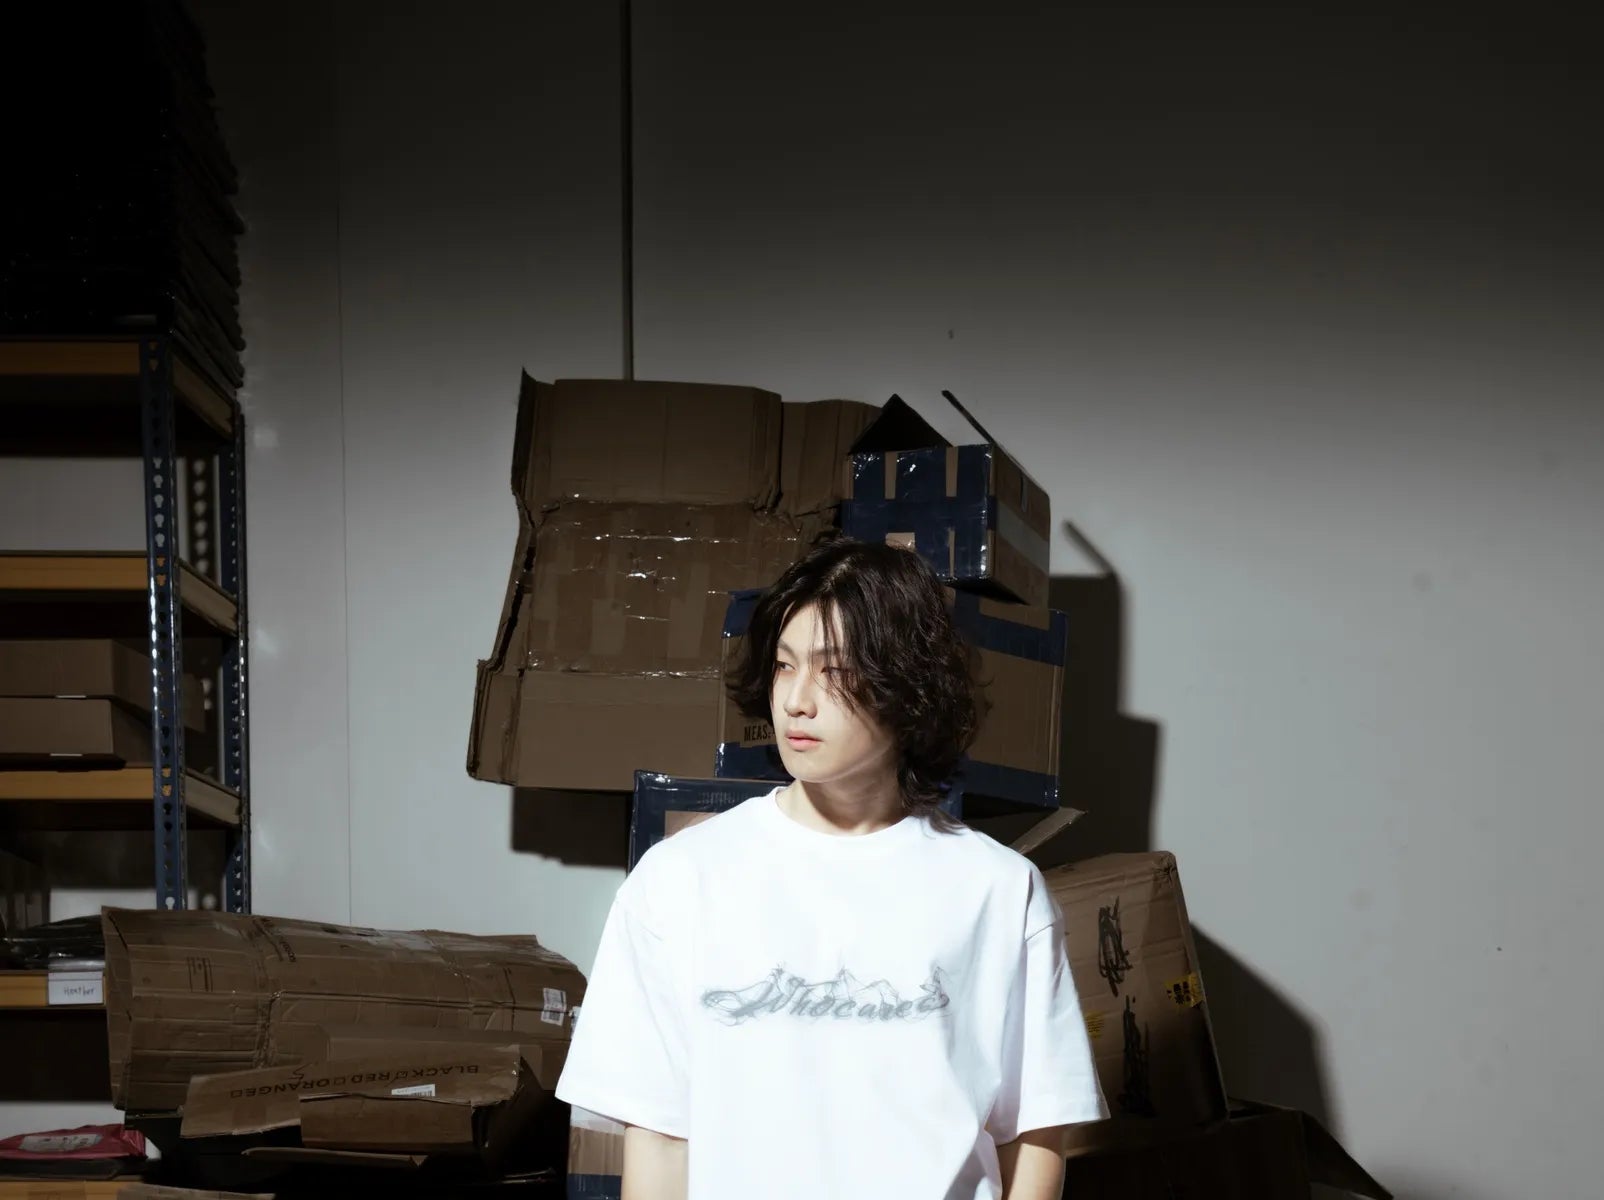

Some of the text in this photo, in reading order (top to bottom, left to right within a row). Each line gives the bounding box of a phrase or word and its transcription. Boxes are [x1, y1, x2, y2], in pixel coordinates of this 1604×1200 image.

[245, 1064, 479, 1097] BLACK RED ORANGE
